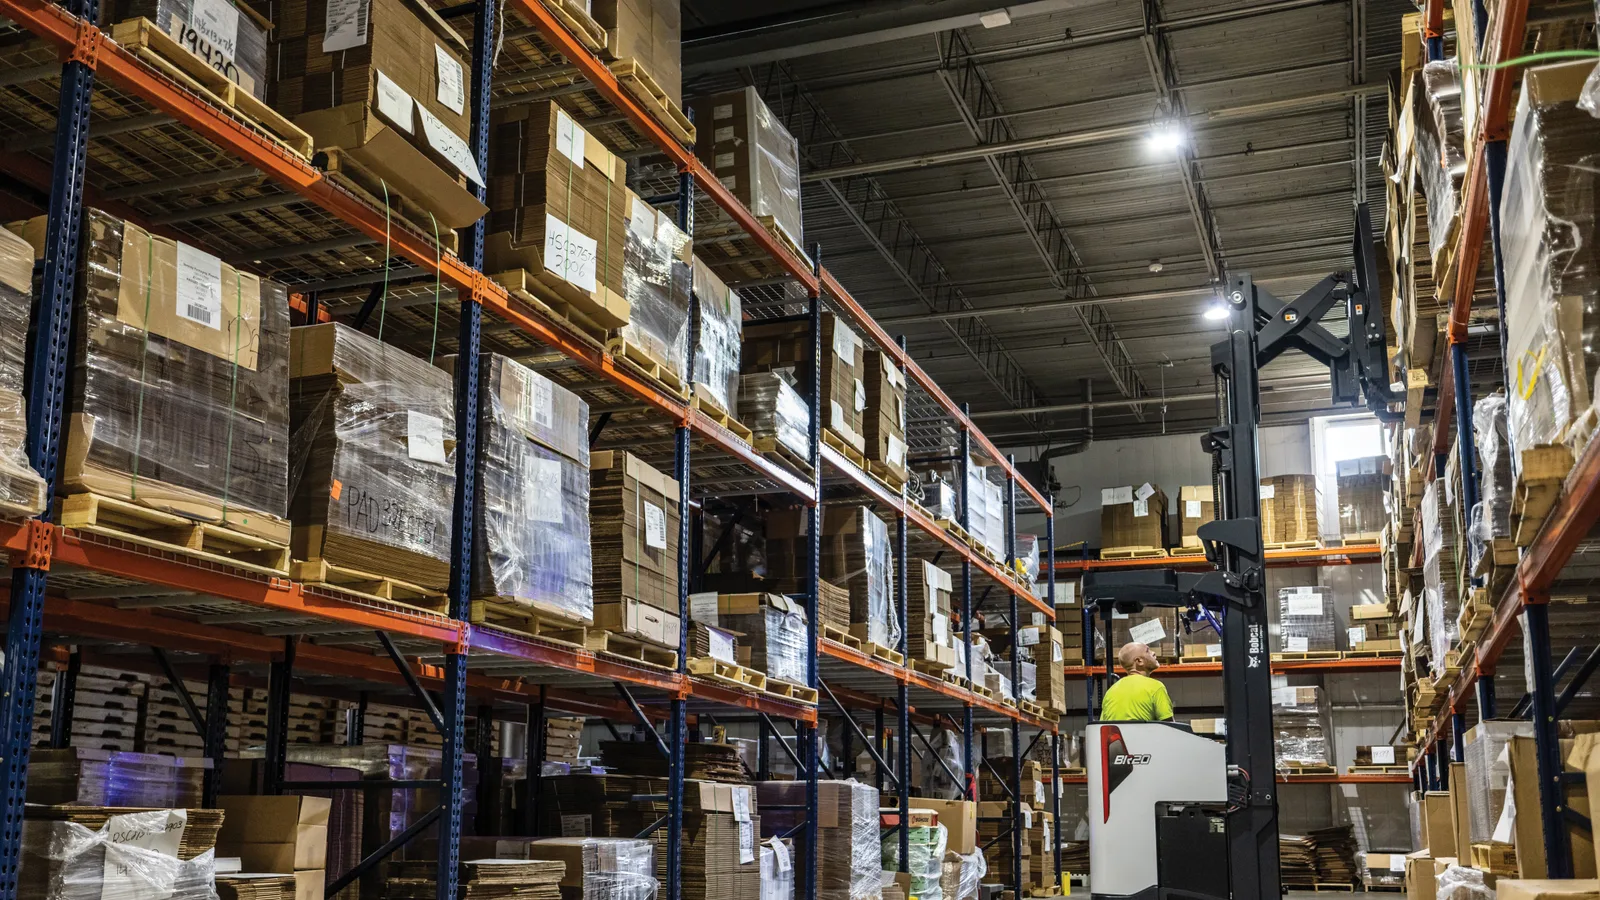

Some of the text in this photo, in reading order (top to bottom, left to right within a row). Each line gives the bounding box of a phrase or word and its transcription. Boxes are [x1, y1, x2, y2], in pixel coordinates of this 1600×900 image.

[555, 253, 586, 279] 2006
[1248, 624, 1260, 653] Bobcat
[1113, 753, 1152, 765] BR20
